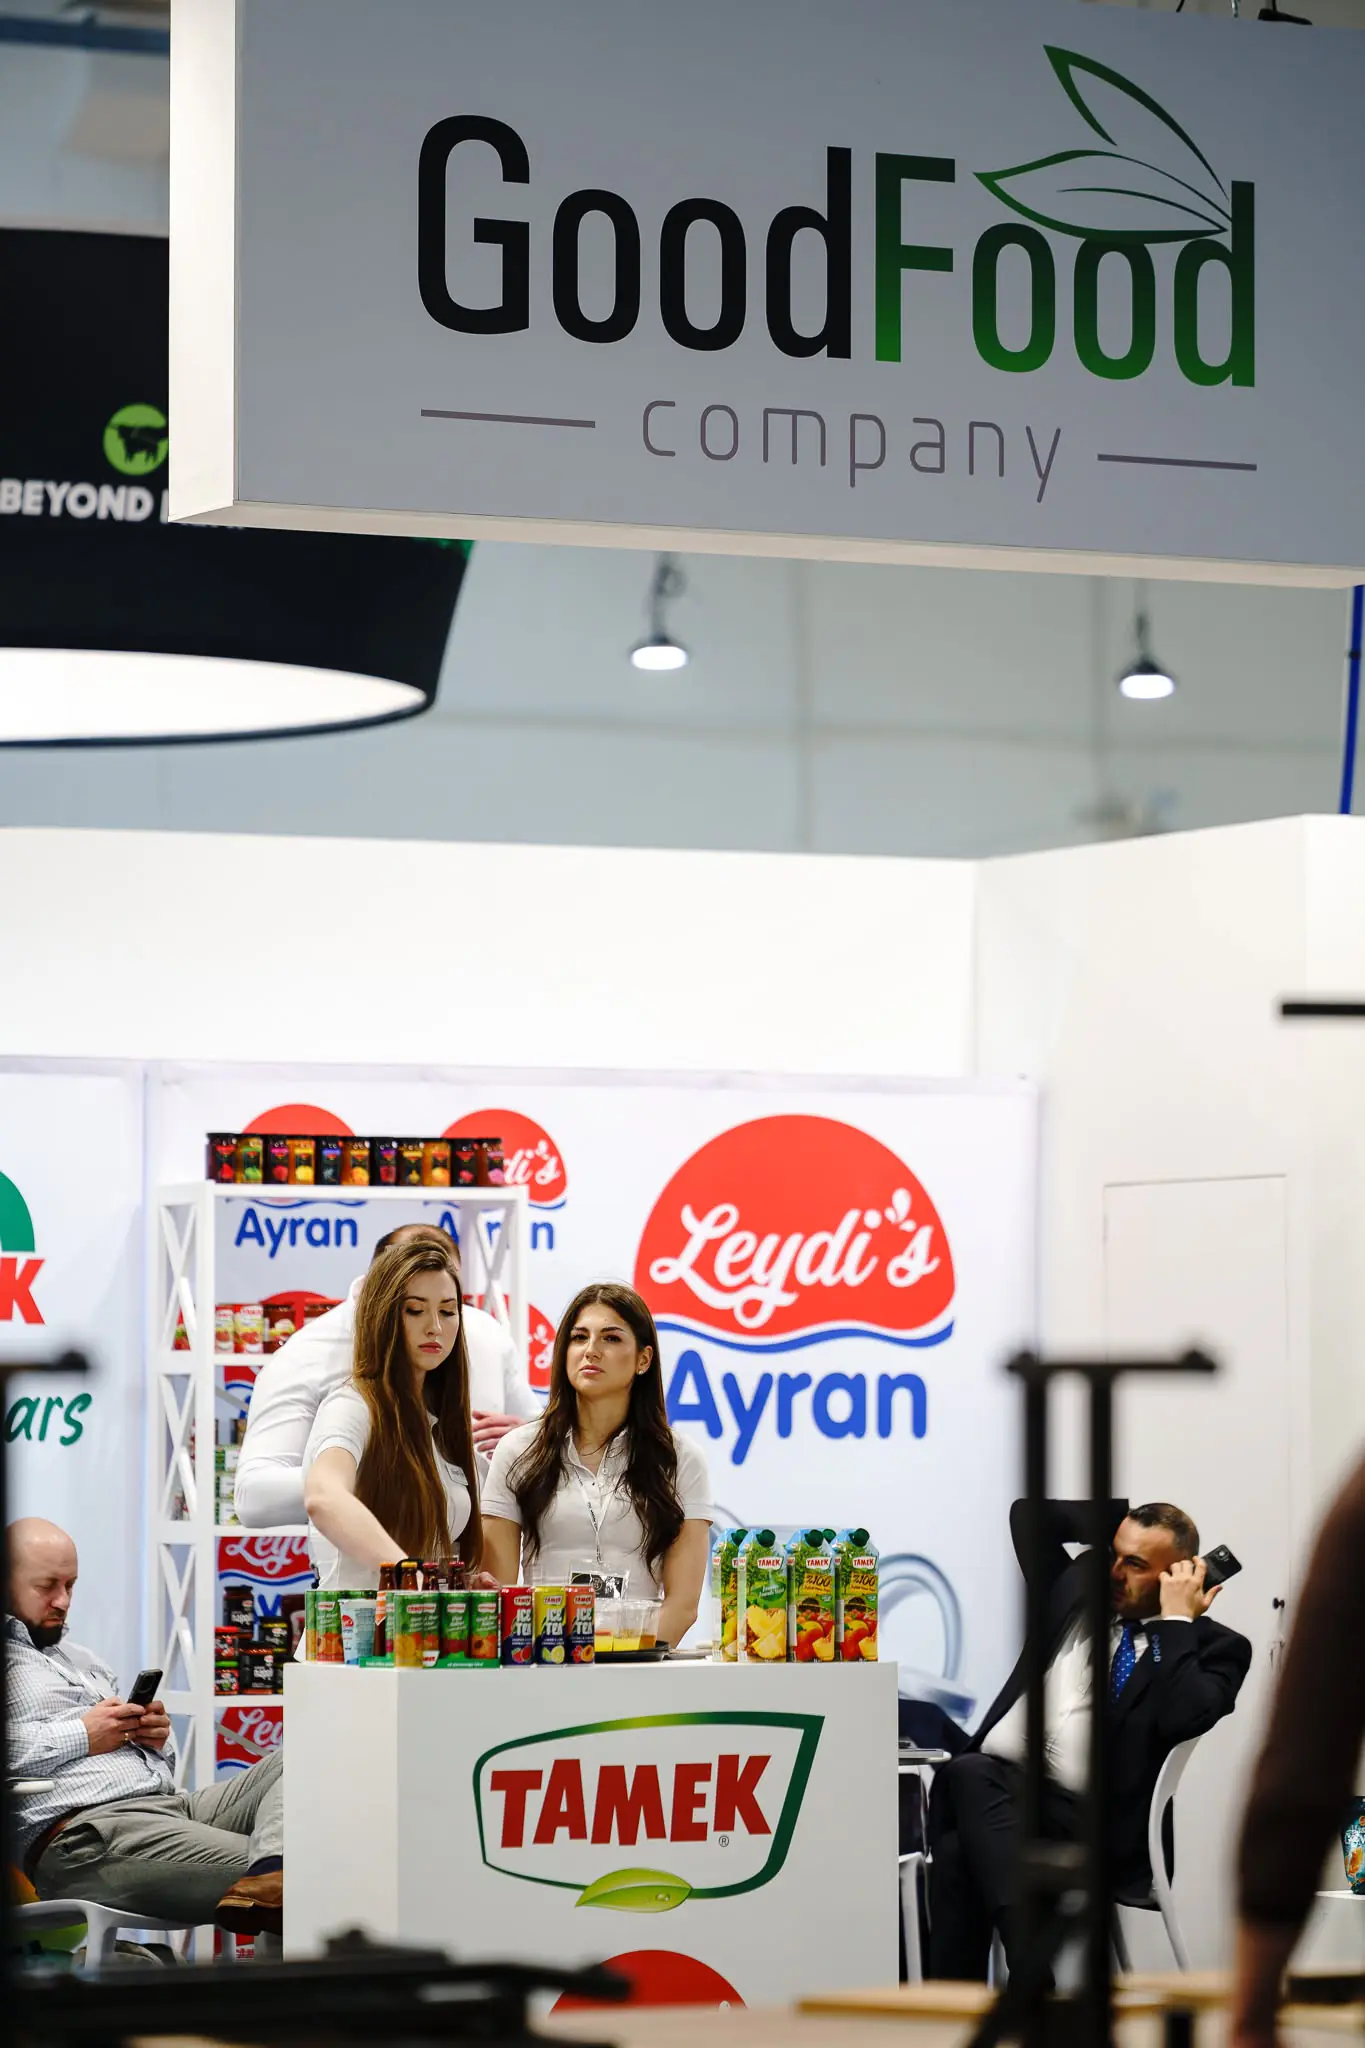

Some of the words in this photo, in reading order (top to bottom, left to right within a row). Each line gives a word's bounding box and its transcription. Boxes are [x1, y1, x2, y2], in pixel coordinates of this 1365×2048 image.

[418, 114, 1256, 388] GoodFood
[643, 400, 1061, 503] company
[0, 478, 154, 522] BEYOND
[235, 1208, 358, 1258] Ayran
[649, 1187, 941, 1328] Leydi's
[666, 1350, 928, 1466] Ayran
[758, 1559, 781, 1567] TAMEK
[807, 1559, 829, 1567] TAMEK
[853, 1558, 874, 1566] TAMEK
[547, 1608, 562, 1621] ICE
[576, 1608, 591, 1620] ICE
[576, 1622, 592, 1634] TEA
[545, 1622, 562, 1635] TEA
[490, 1754, 772, 1848] TAMEK
